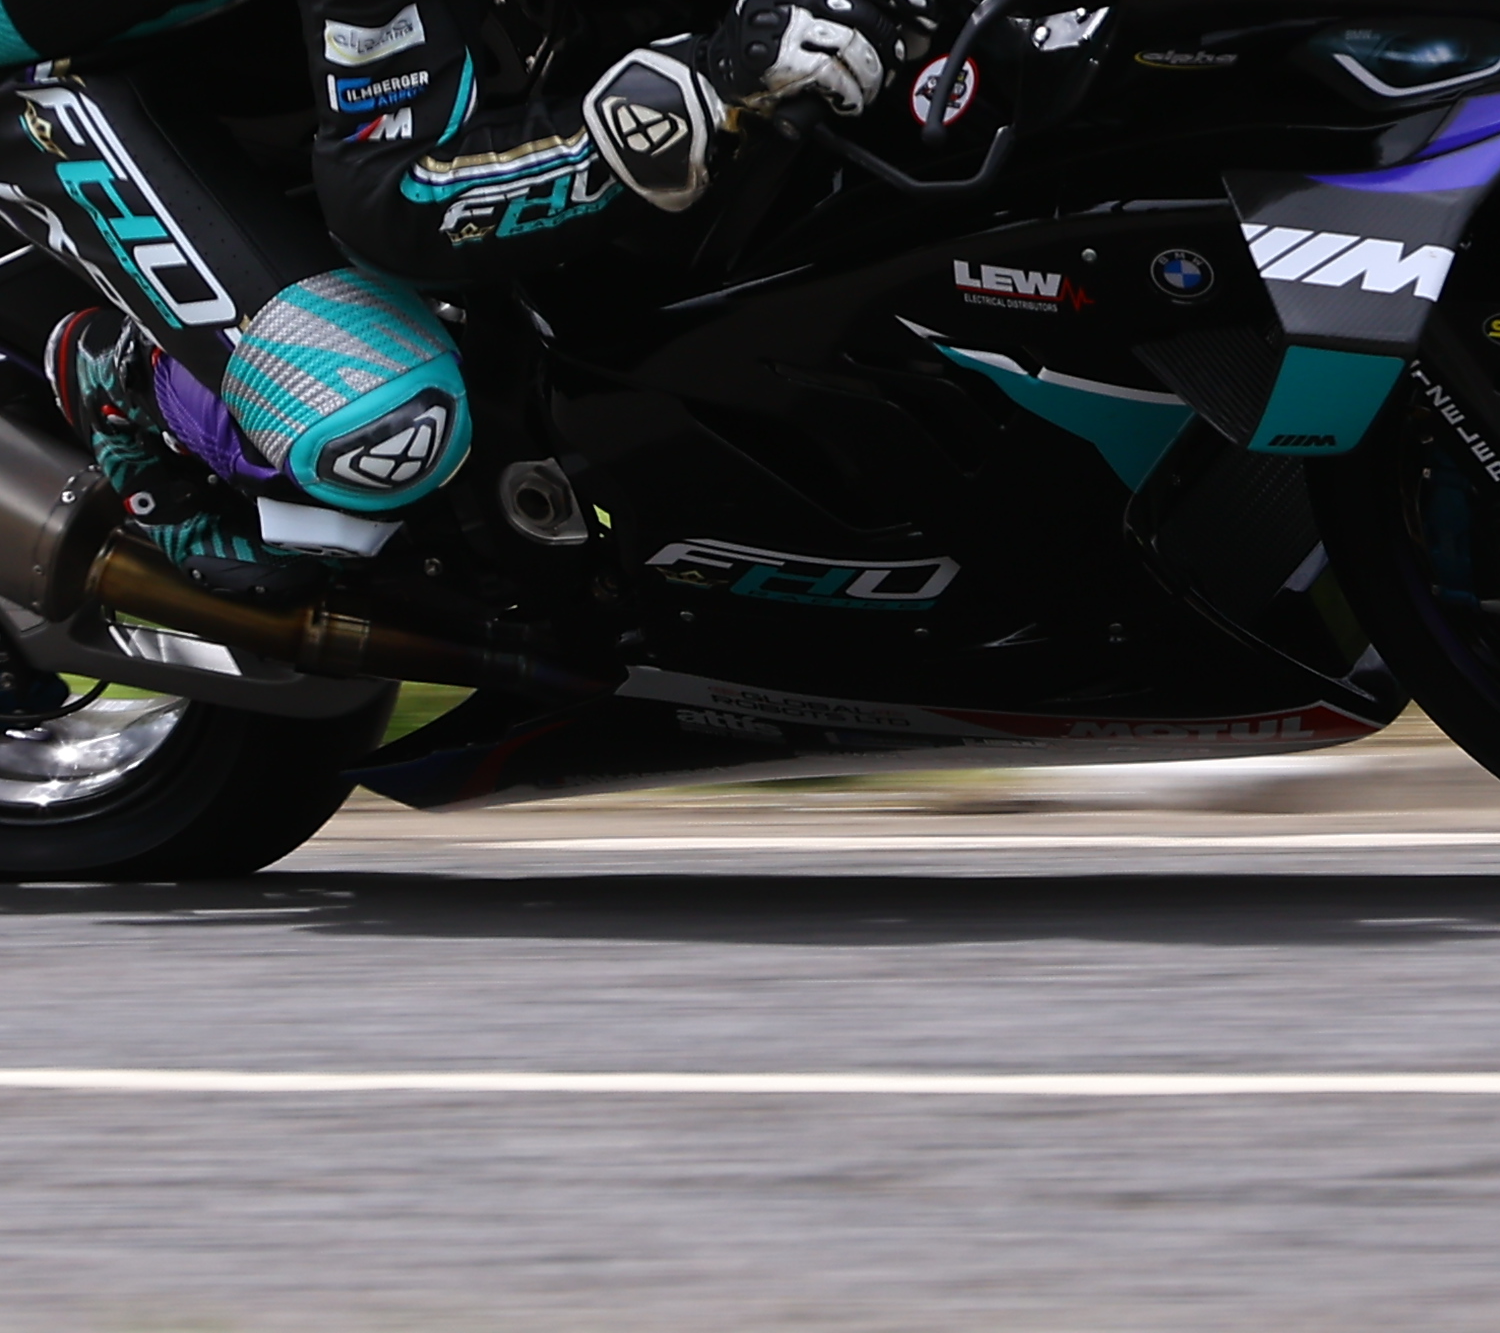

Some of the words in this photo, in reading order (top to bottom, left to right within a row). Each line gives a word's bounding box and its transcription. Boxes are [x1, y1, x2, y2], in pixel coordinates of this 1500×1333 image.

[953, 259, 1063, 299] LEW
[963, 294, 1005, 309] ELECTRICAL
[1007, 298, 1059, 314] DISTRIBUTORS
[855, 713, 912, 728] LTD
[1068, 715, 1315, 741] MOTUL
